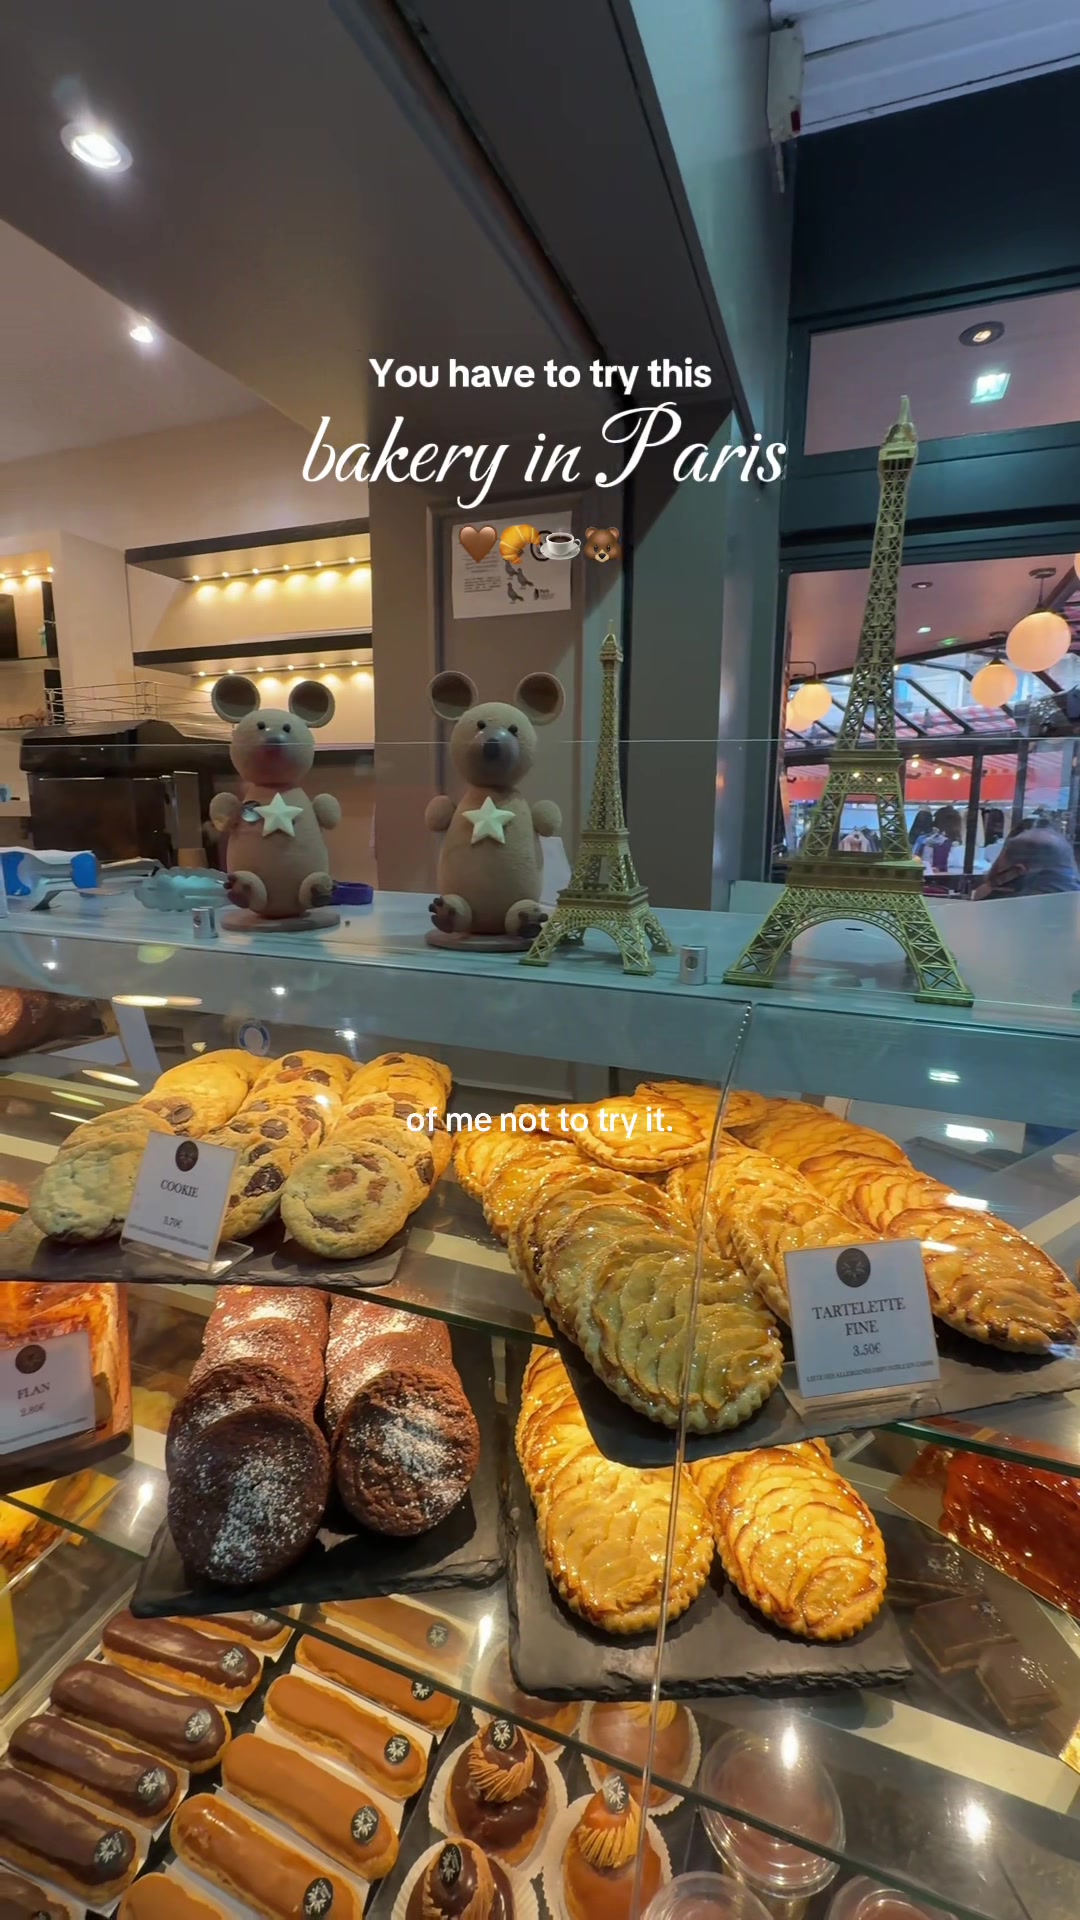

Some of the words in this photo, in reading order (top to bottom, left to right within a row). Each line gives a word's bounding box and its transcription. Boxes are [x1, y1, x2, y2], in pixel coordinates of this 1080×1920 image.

[160, 1179, 199, 1198] COOKIE
[812, 1297, 906, 1320] TARTELETTE
[845, 1320, 879, 1336] FINE
[17, 1382, 51, 1399] FLAN
